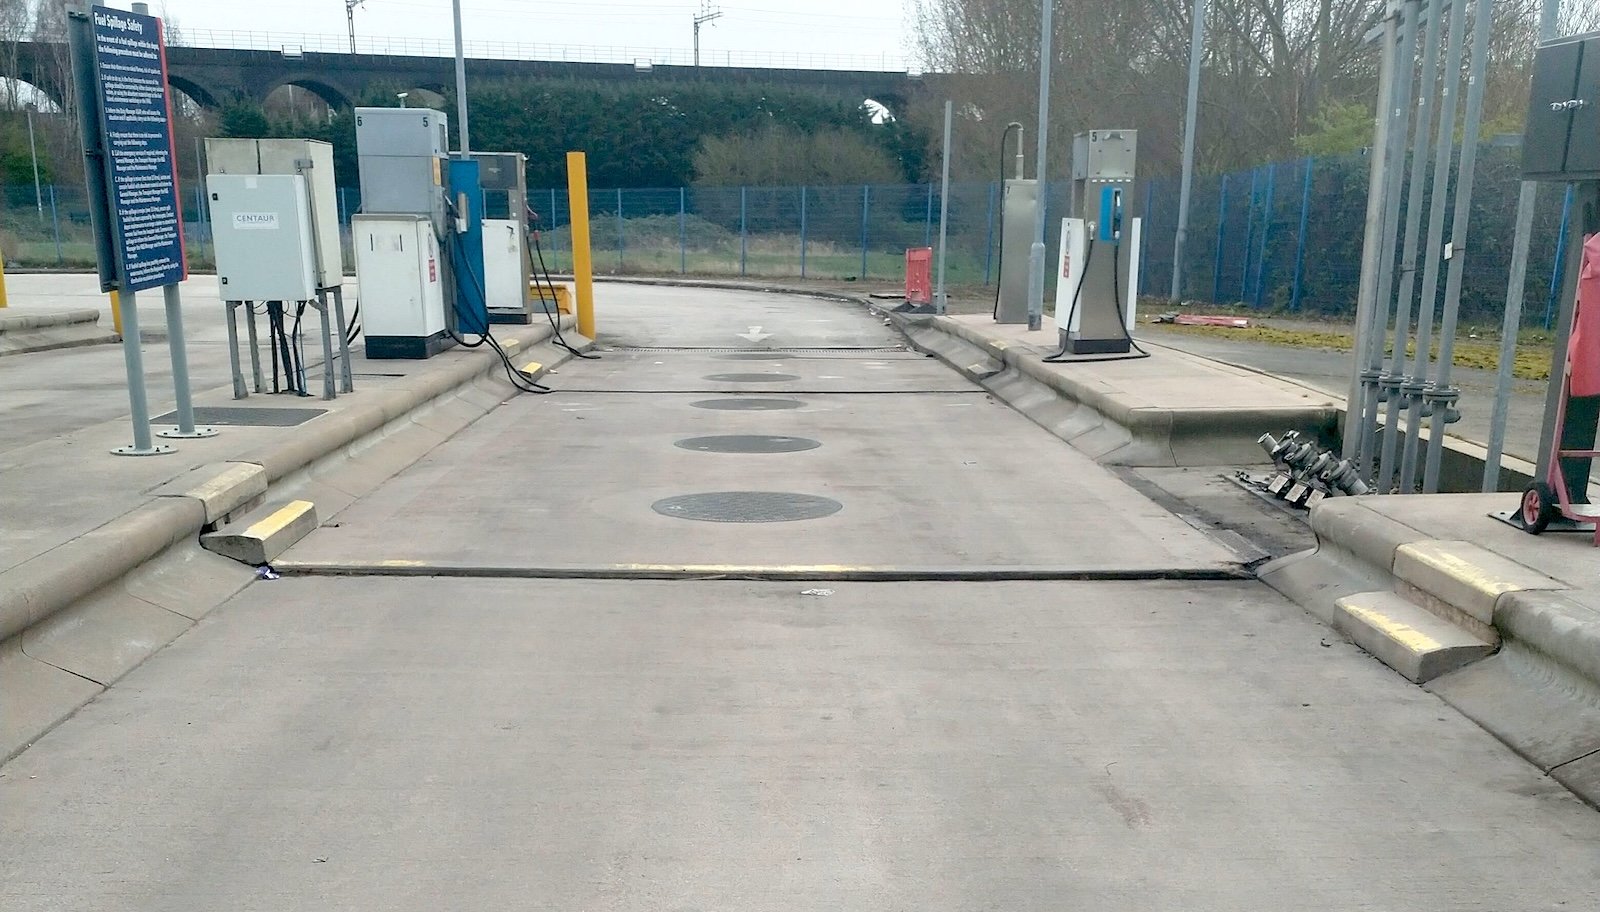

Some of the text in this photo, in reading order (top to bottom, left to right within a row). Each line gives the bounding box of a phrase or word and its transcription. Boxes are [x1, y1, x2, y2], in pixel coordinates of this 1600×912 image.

[94, 12, 143, 35] Fuel Spillage Safety
[357, 116, 363, 127] 6
[423, 116, 429, 127] 5
[1092, 131, 1097, 142] 5
